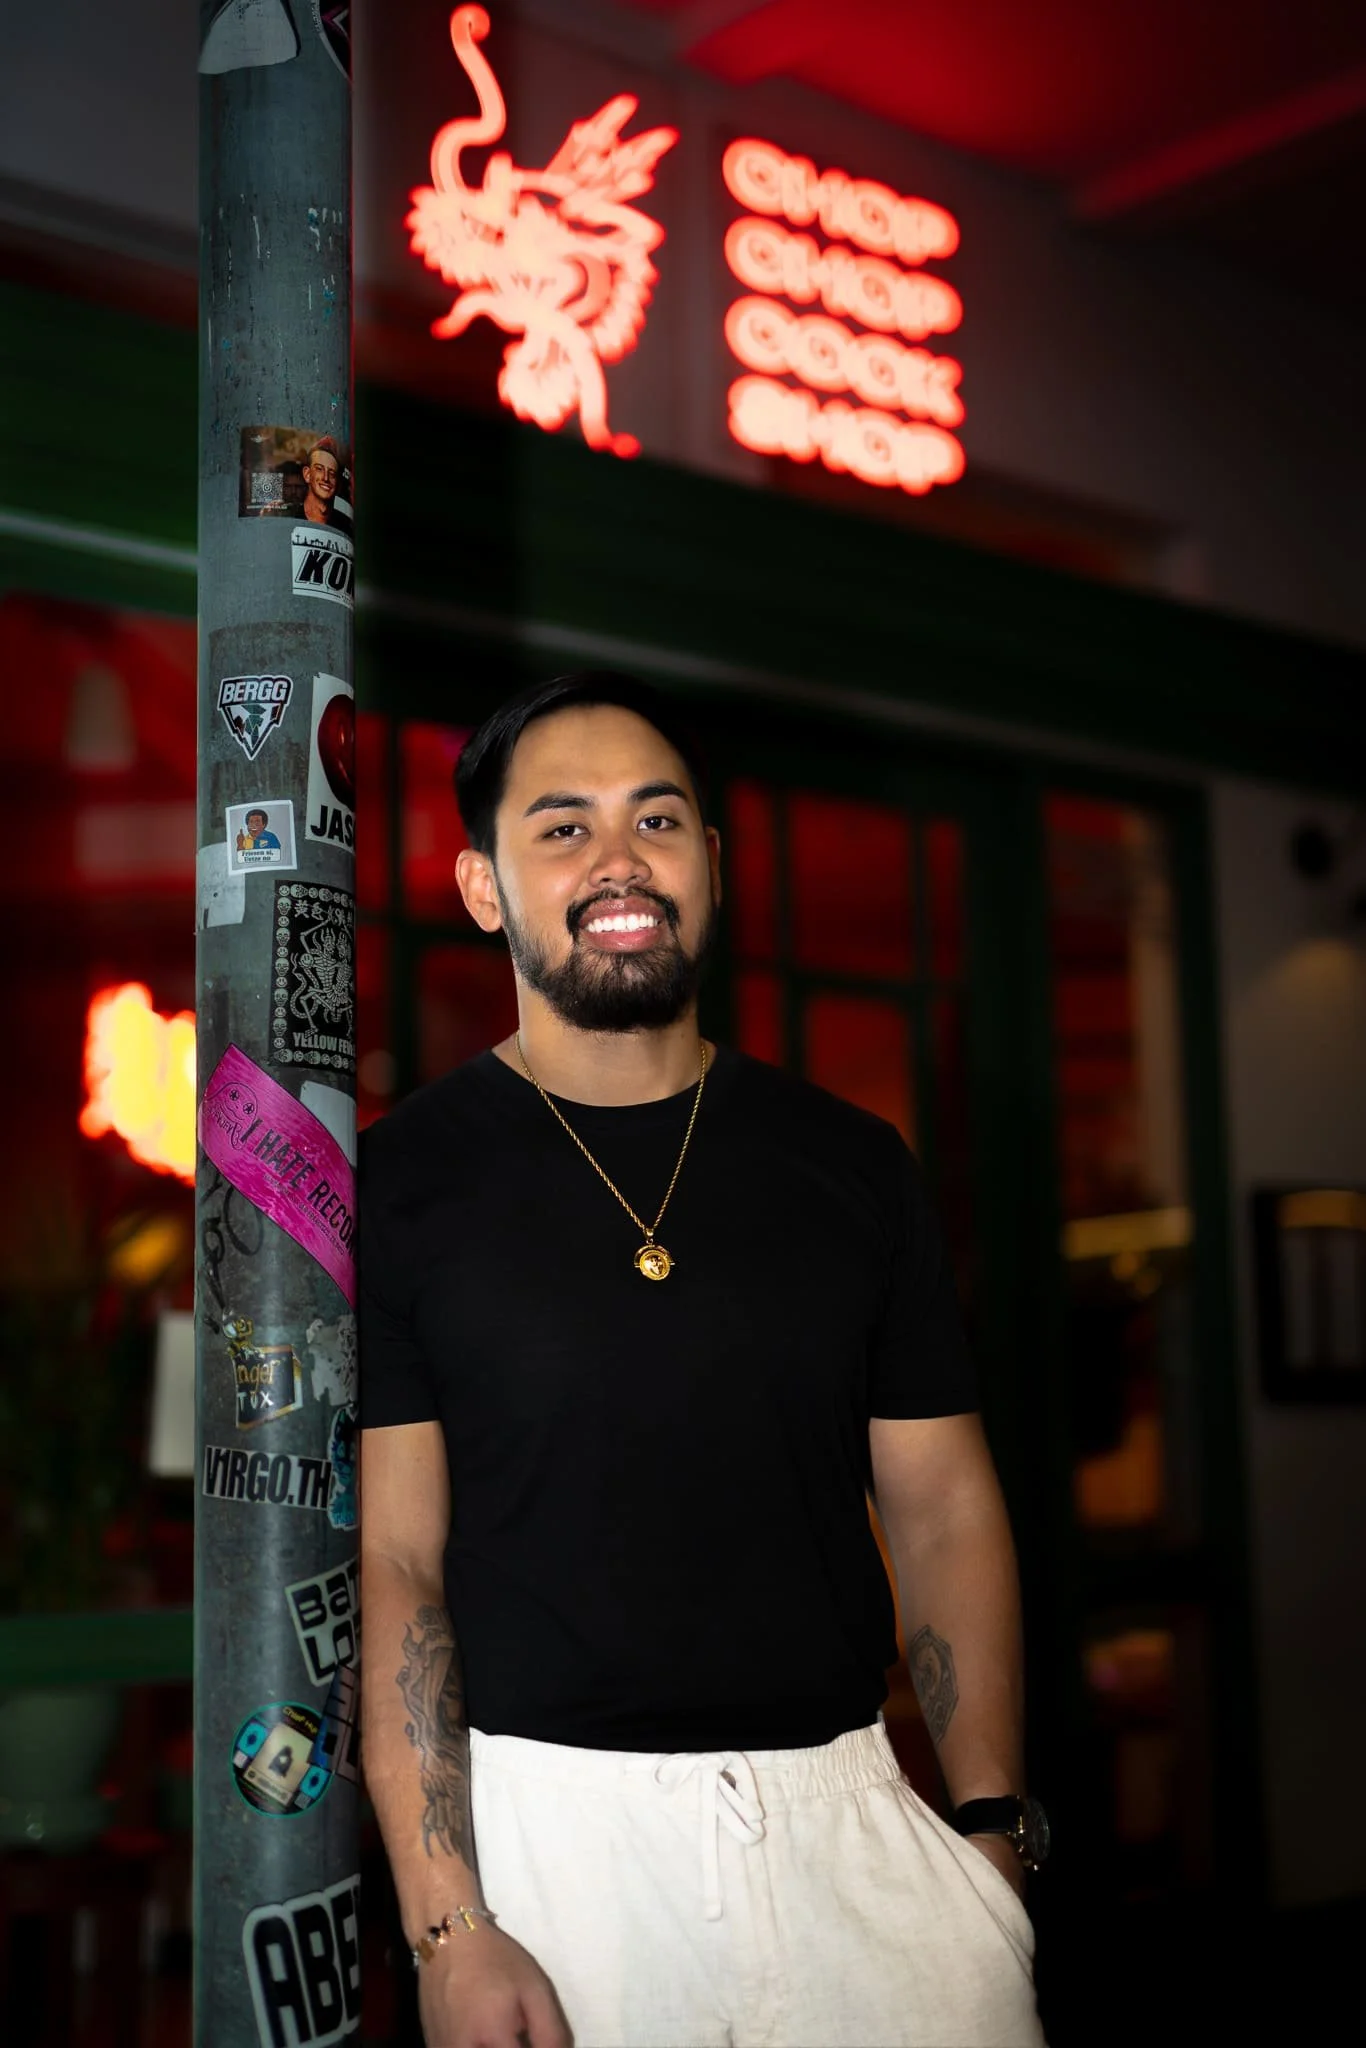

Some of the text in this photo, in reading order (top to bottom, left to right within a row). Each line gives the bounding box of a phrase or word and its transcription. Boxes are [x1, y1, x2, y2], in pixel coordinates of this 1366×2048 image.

[722, 137, 960, 266] CHOP
[724, 216, 963, 341] CHOP
[724, 295, 965, 428] COOK
[727, 374, 966, 496] SHOP
[221, 679, 289, 705] BERGG
[292, 1031, 337, 1051] YELLOW
[240, 1118, 263, 1143] I
[254, 1129, 316, 1189] HATE
[237, 1391, 274, 1413] TUX
[253, 1882, 361, 2048] ABE
